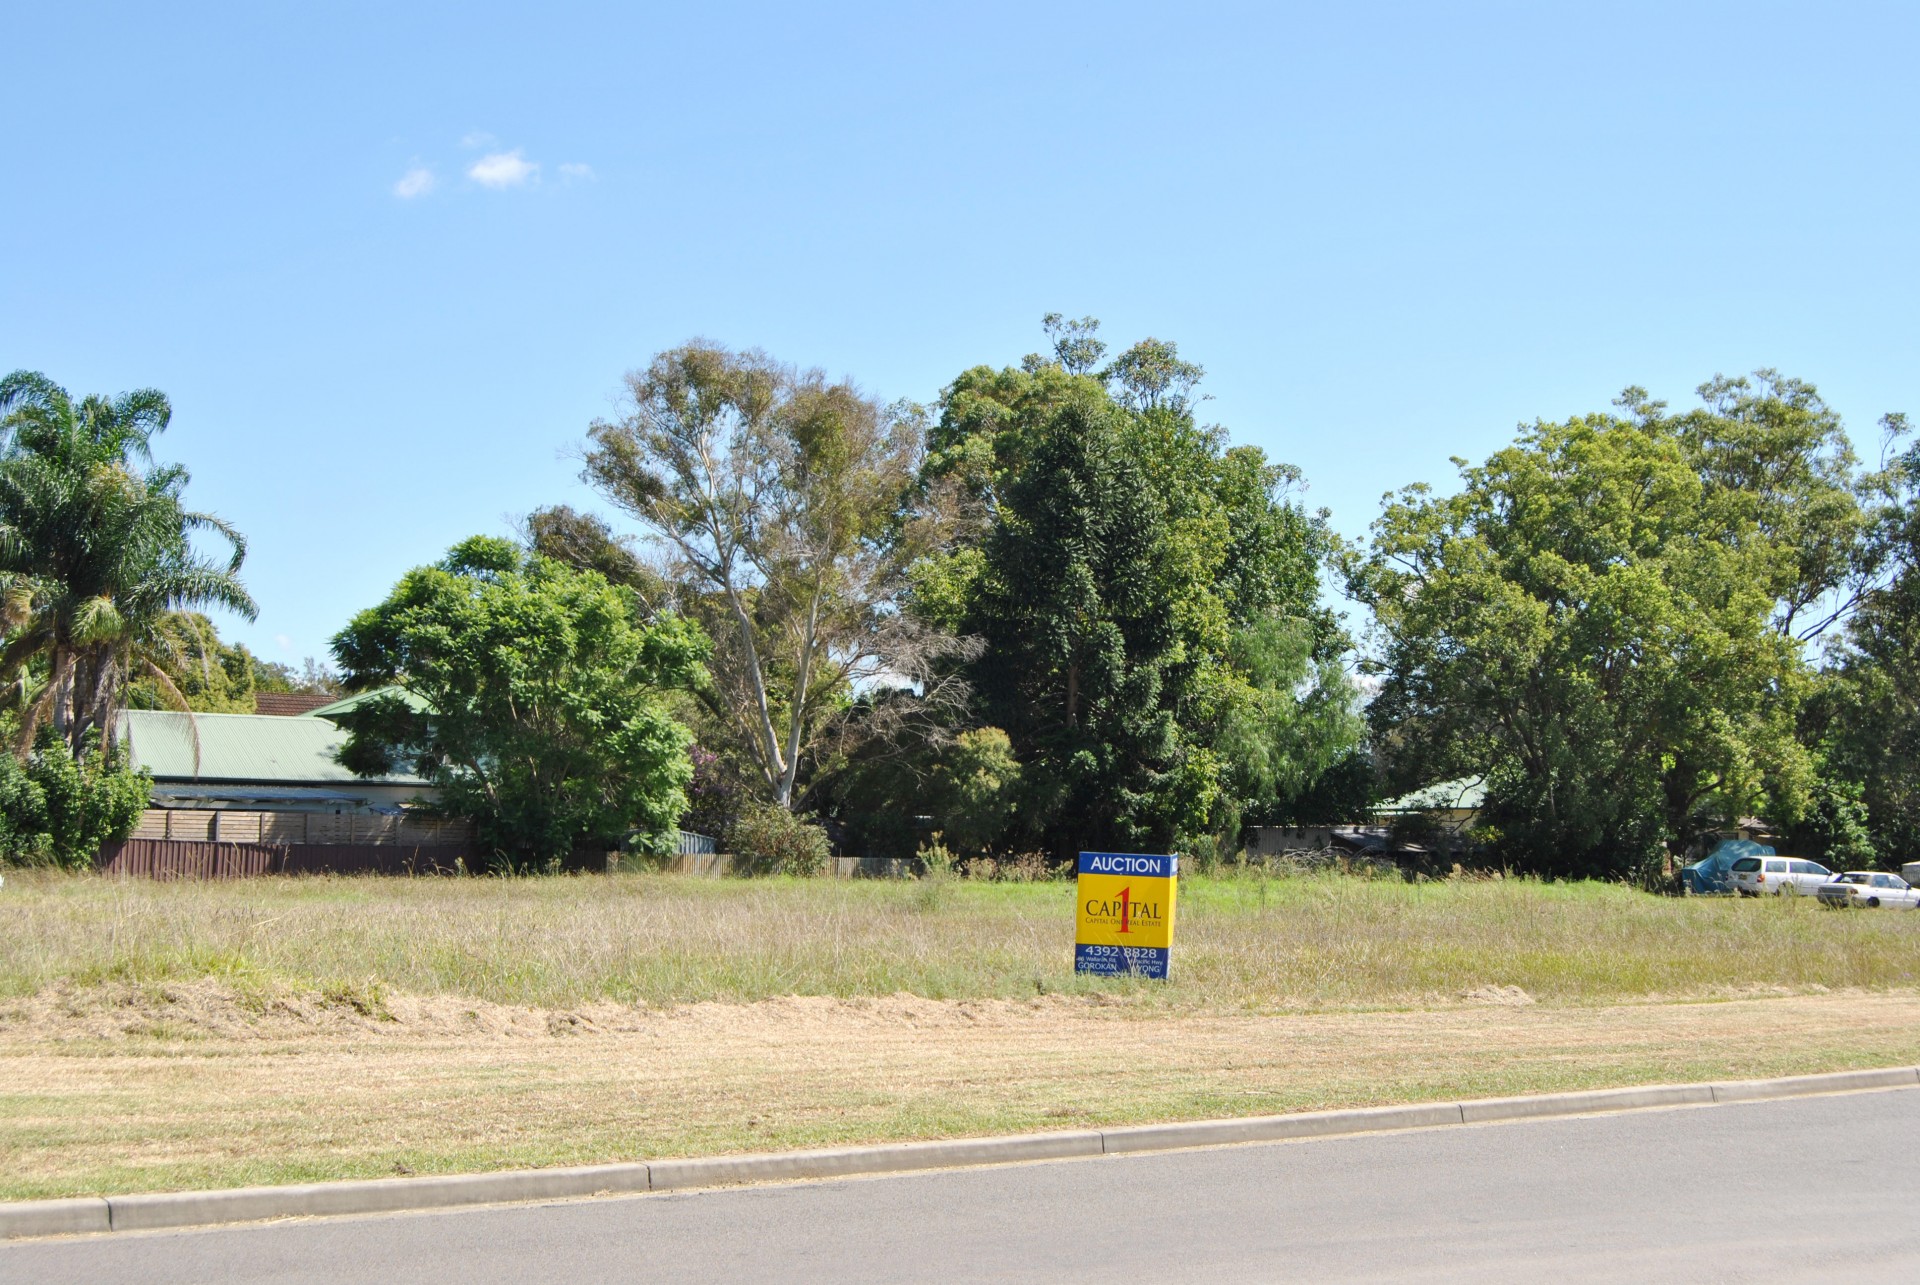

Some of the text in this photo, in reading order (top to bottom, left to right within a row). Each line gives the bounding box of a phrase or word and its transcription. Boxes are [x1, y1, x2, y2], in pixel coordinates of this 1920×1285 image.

[1090, 856, 1160, 873] AUCTION
[1086, 899, 1162, 919] CAPITAL
[1115, 886, 1134, 934] 1
[1085, 917, 1109, 925] CAPITAL
[1085, 946, 1157, 959] 4392 8828
[1078, 962, 1117, 970] GOROKAN
